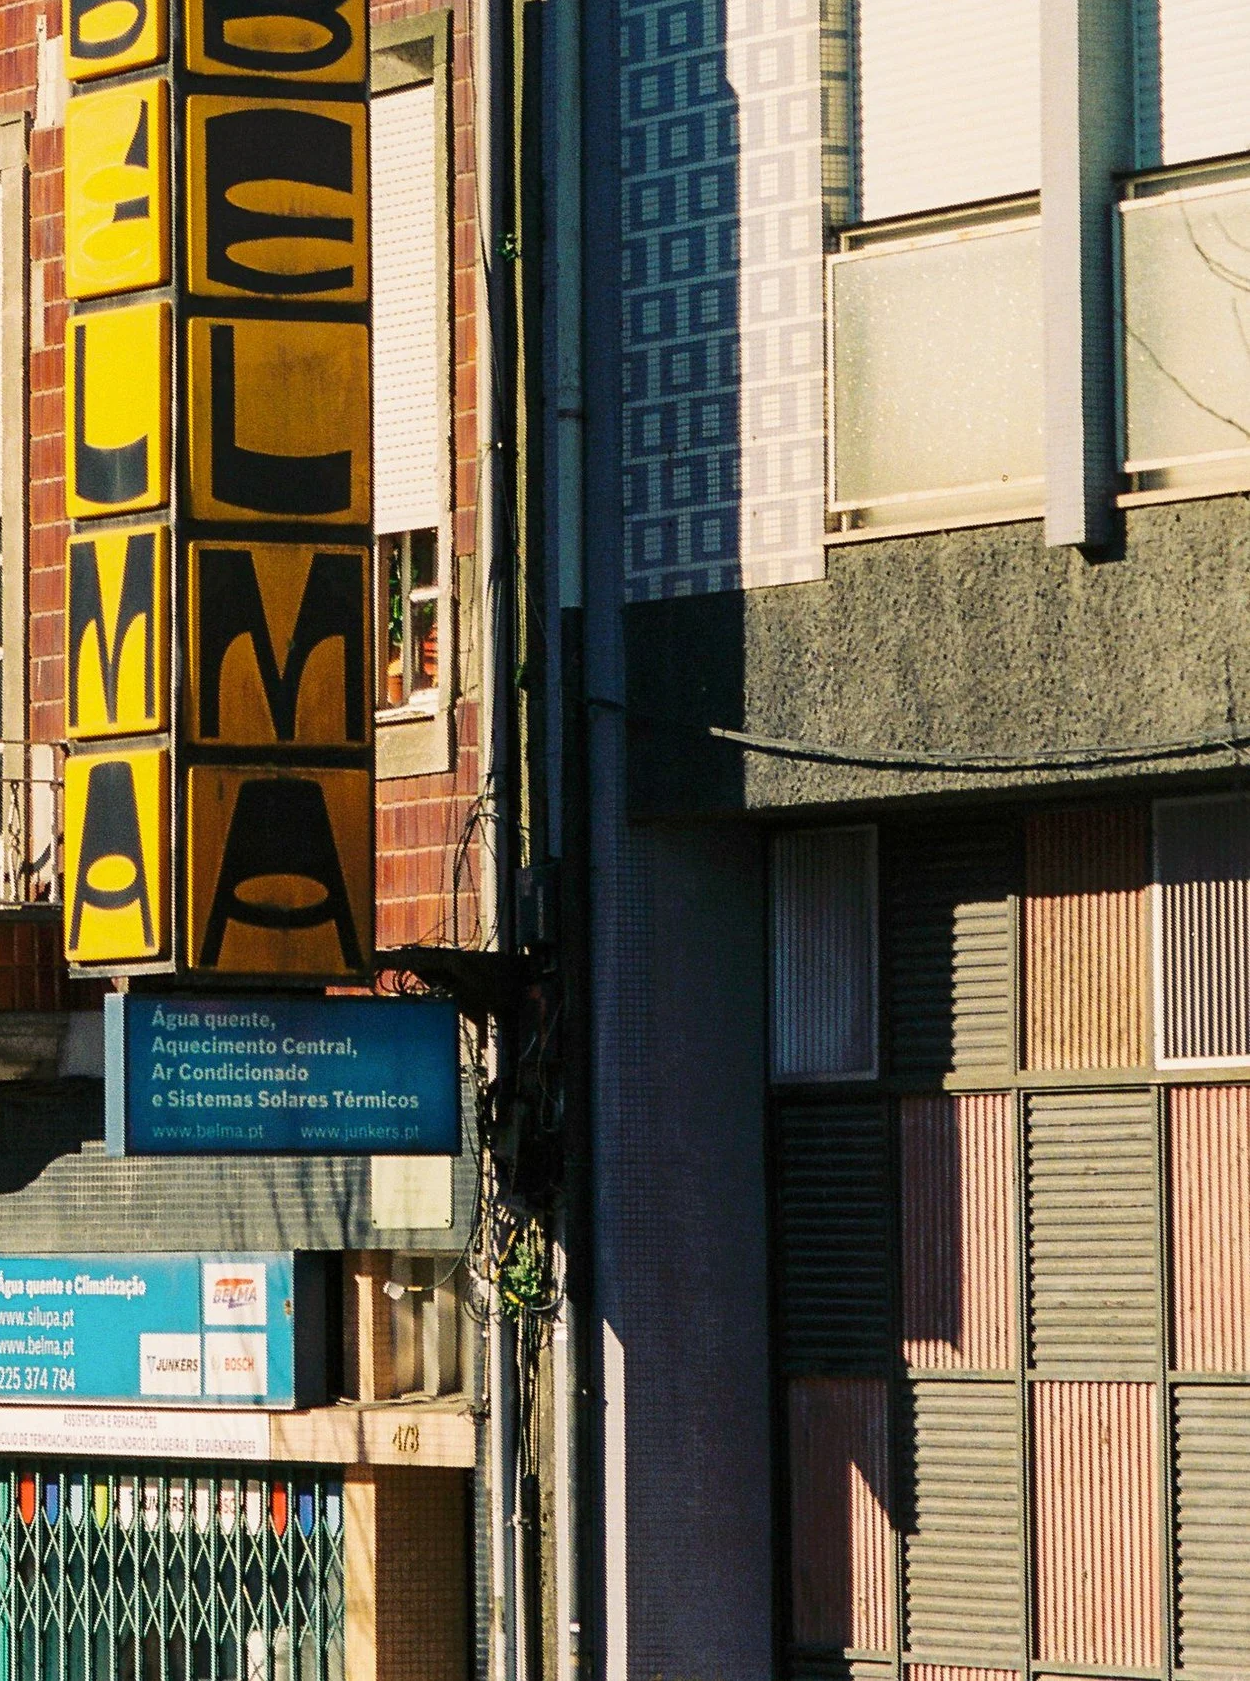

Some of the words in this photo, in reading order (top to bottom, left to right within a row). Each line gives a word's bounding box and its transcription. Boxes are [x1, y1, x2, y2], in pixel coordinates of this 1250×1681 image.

[152, 1005, 200, 1029] Água
[204, 1012, 277, 1030] quente,
[152, 1036, 278, 1056] Aquecimento
[282, 1037, 358, 1057] Central,
[152, 1063, 175, 1081] Ar
[179, 1063, 309, 1082] Condicionado
[152, 1094, 163, 1107] e
[167, 1090, 253, 1108] Sistemas
[258, 1090, 329, 1108] Solares
[333, 1090, 419, 1108] Térmicos
[152, 1123, 263, 1140] www.belma.pt
[301, 1124, 419, 1142] www.junkers.pt
[26, 1277, 63, 1297] quente
[65, 1280, 73, 1295] e
[74, 1274, 147, 1300] Climatização
[213, 1282, 257, 1309] BELMA
[156, 1357, 199, 1372] JUNKERS
[225, 1357, 254, 1372] BOSCH
[24, 1367, 48, 1390] 374
[52, 1368, 76, 1391] 784
